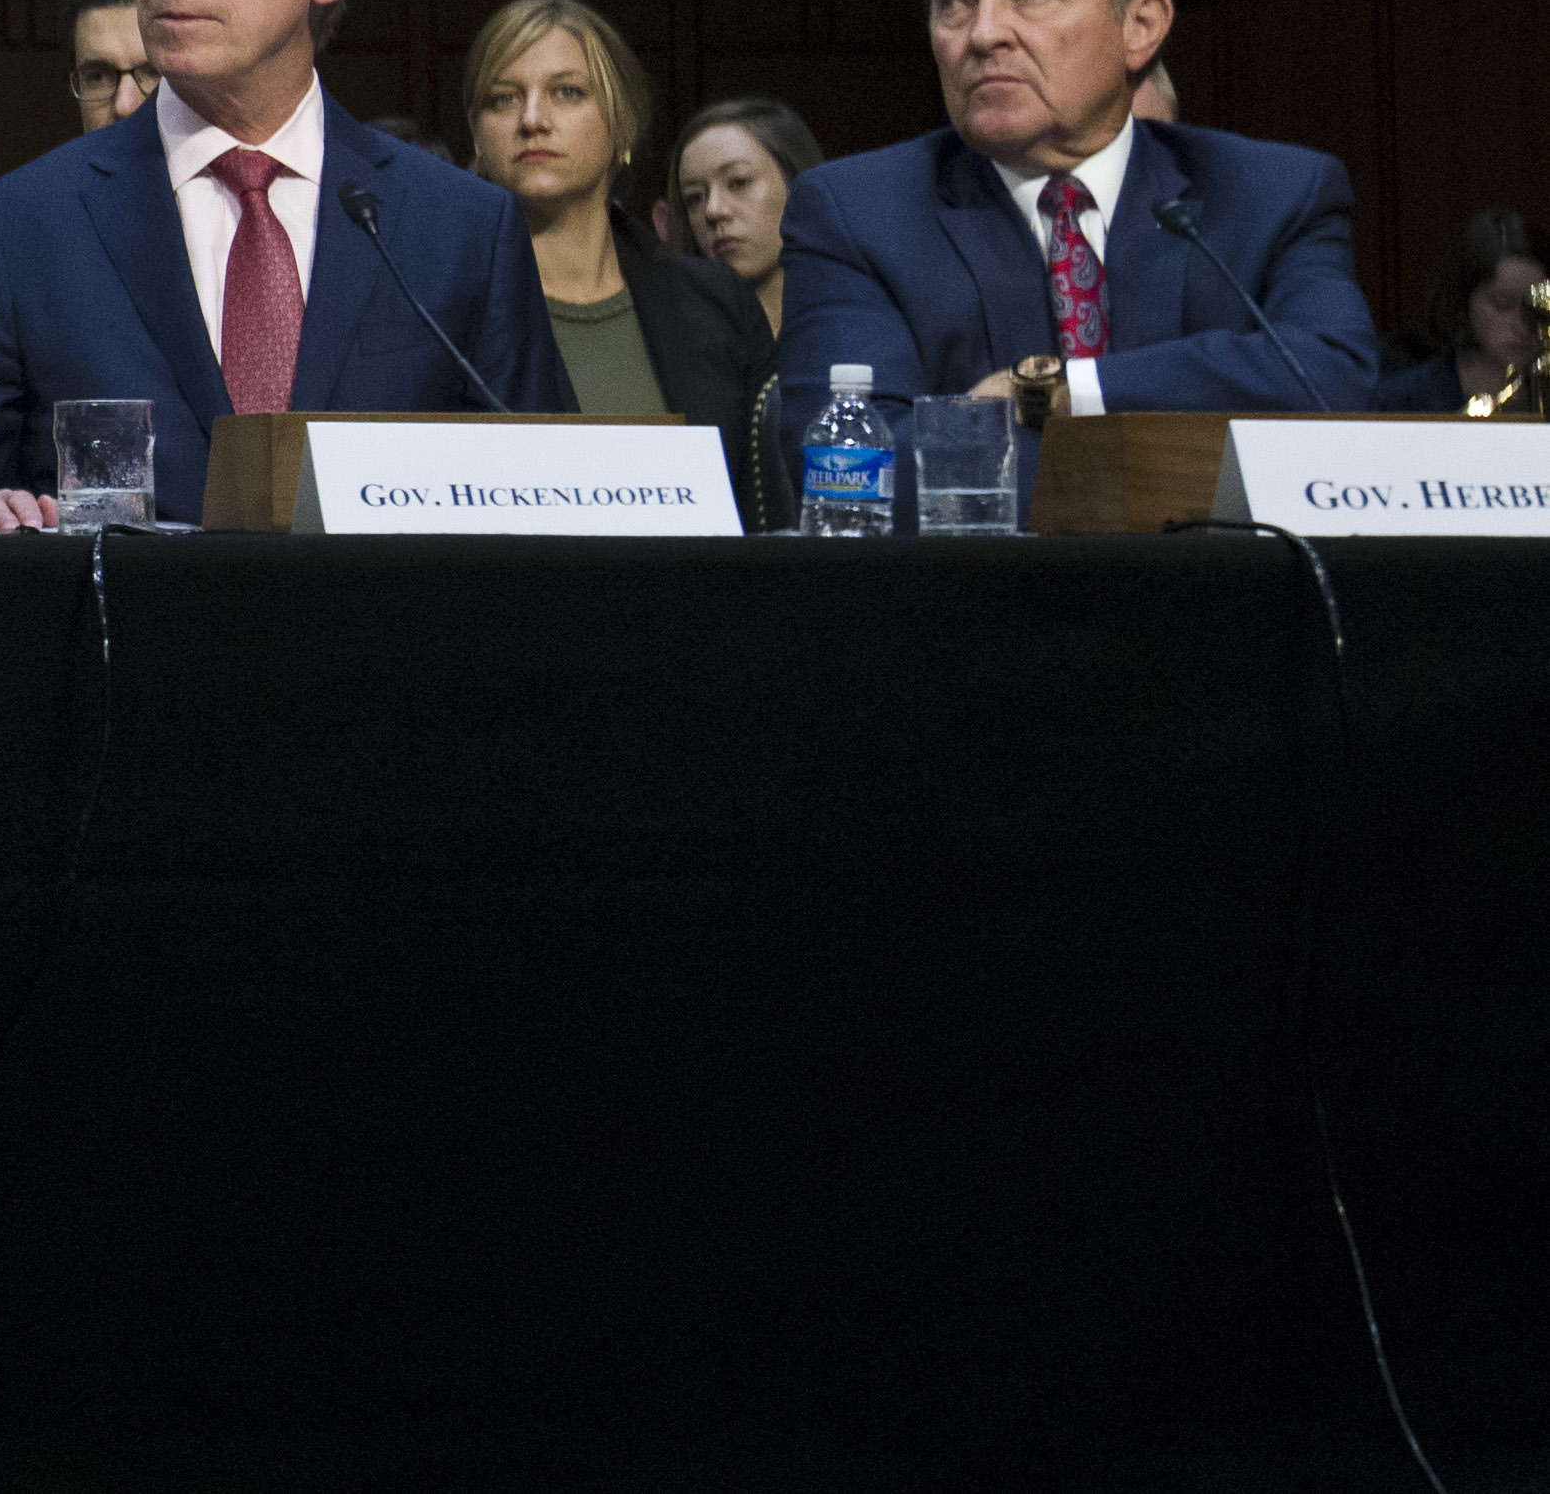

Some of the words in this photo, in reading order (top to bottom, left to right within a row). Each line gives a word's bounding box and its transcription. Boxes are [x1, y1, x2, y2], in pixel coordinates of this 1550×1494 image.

[835, 471, 871, 486] PARK
[360, 484, 442, 507] GOV.
[449, 483, 697, 507] HICKENLOOPER
[1305, 481, 1409, 509] GOV.
